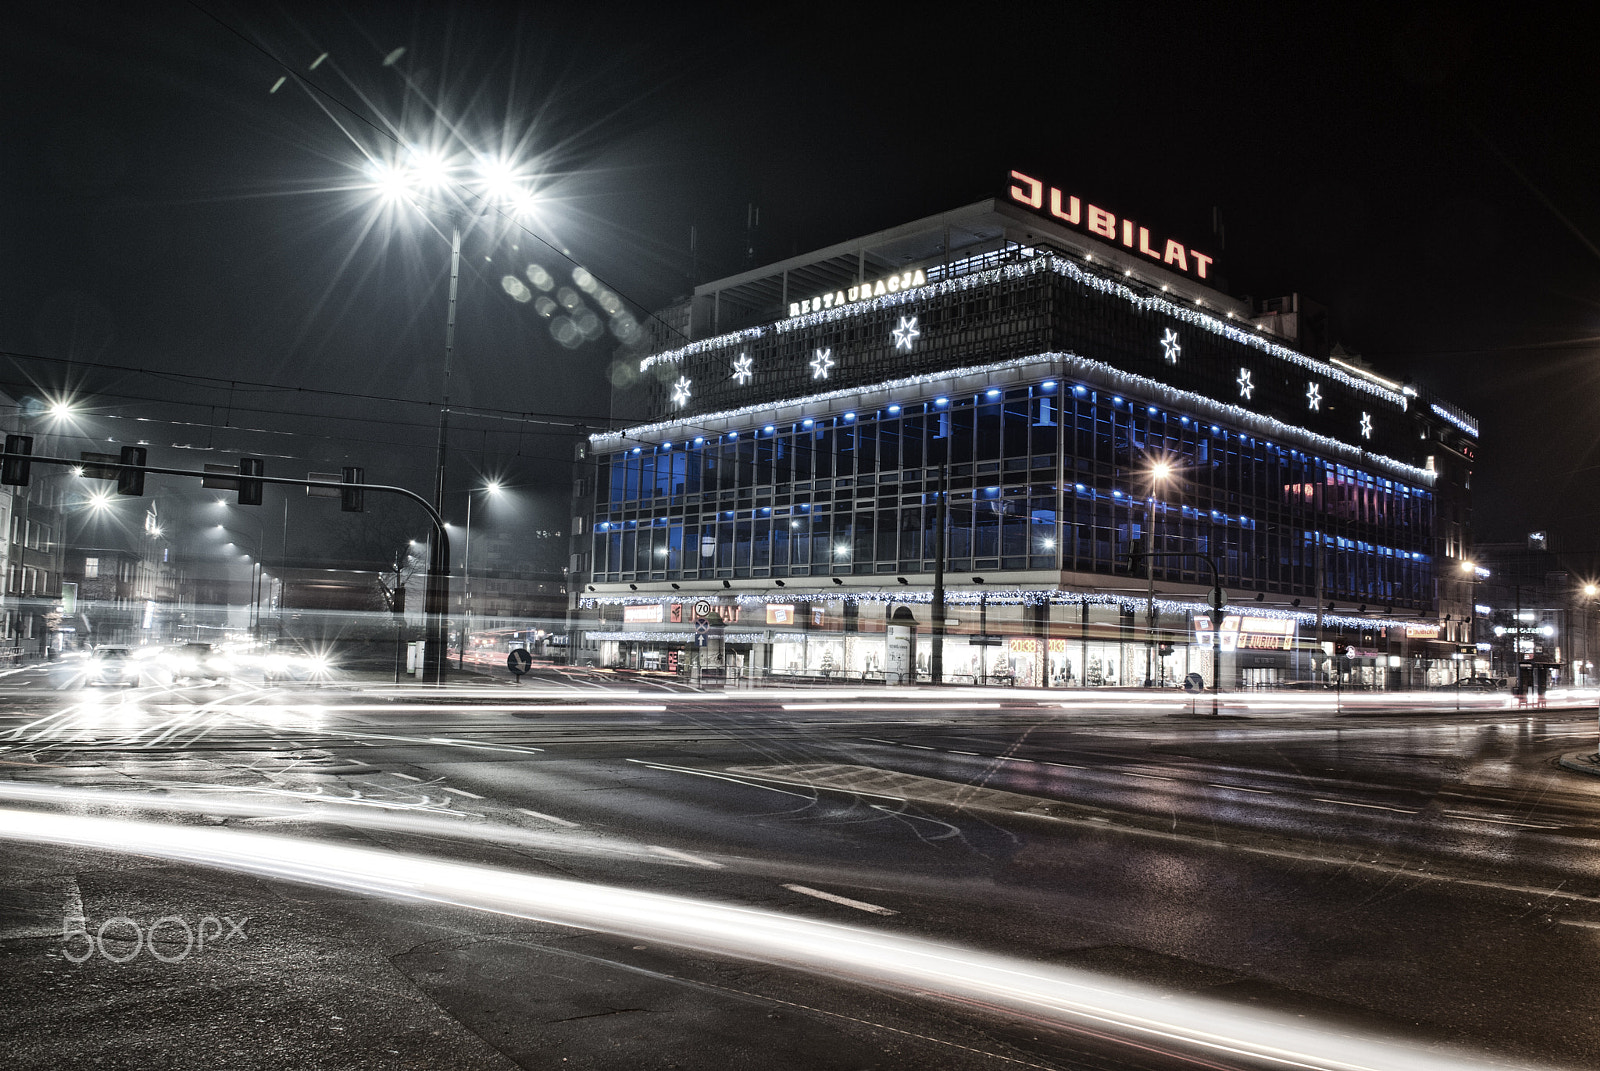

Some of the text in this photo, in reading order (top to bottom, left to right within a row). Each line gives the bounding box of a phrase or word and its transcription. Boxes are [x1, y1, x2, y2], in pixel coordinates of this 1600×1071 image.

[1010, 169, 1213, 279] JUBILAT
[789, 269, 926, 318] RESTAURACJA
[697, 604, 709, 613] 70
[1248, 635, 1280, 650] JUBILAT
